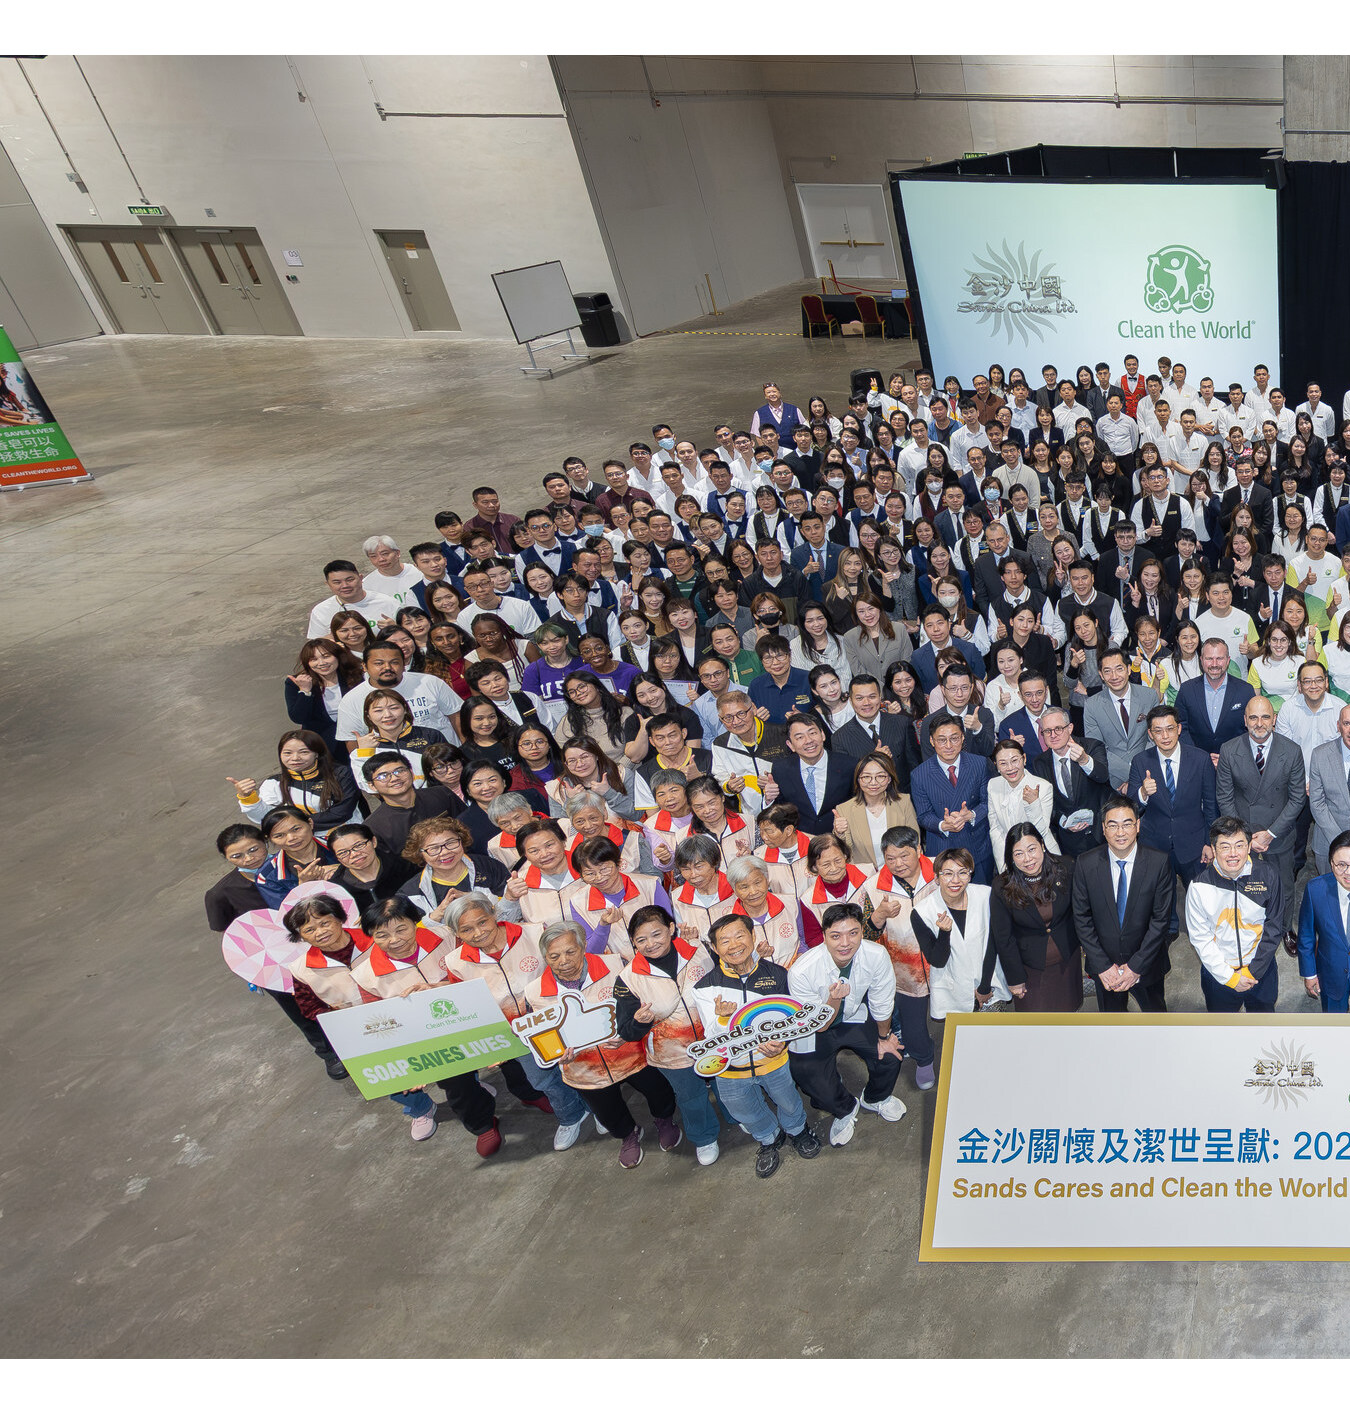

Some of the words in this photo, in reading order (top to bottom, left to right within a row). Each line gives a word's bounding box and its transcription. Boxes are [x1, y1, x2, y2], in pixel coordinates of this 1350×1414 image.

[966, 273, 1062, 300] 金沙中國
[1008, 300, 1052, 313] China
[1118, 319, 1165, 338] Clean
[1169, 320, 1196, 339] the
[4, 429, 31, 437] SAVES
[32, 427, 55, 435] LIVES
[2, 465, 77, 478] CLEANTHEWORLD.ORG
[516, 1007, 557, 1032] LIKE
[690, 1025, 754, 1056] Sands
[760, 1003, 815, 1032] Cares
[730, 1007, 831, 1056] Ambassador
[1253, 1059, 1315, 1077] 金沙中國
[1278, 1077, 1306, 1088] China
[956, 1127, 1280, 1164] 金沙關懷及潔世呈獻:
[952, 1177, 1027, 1198] Sands
[1033, 1177, 1104, 1198] Cares
[1110, 1177, 1155, 1198] and
[1161, 1177, 1228, 1198] Clean
[1235, 1177, 1273, 1198] the
[1279, 1177, 1348, 1199] World
